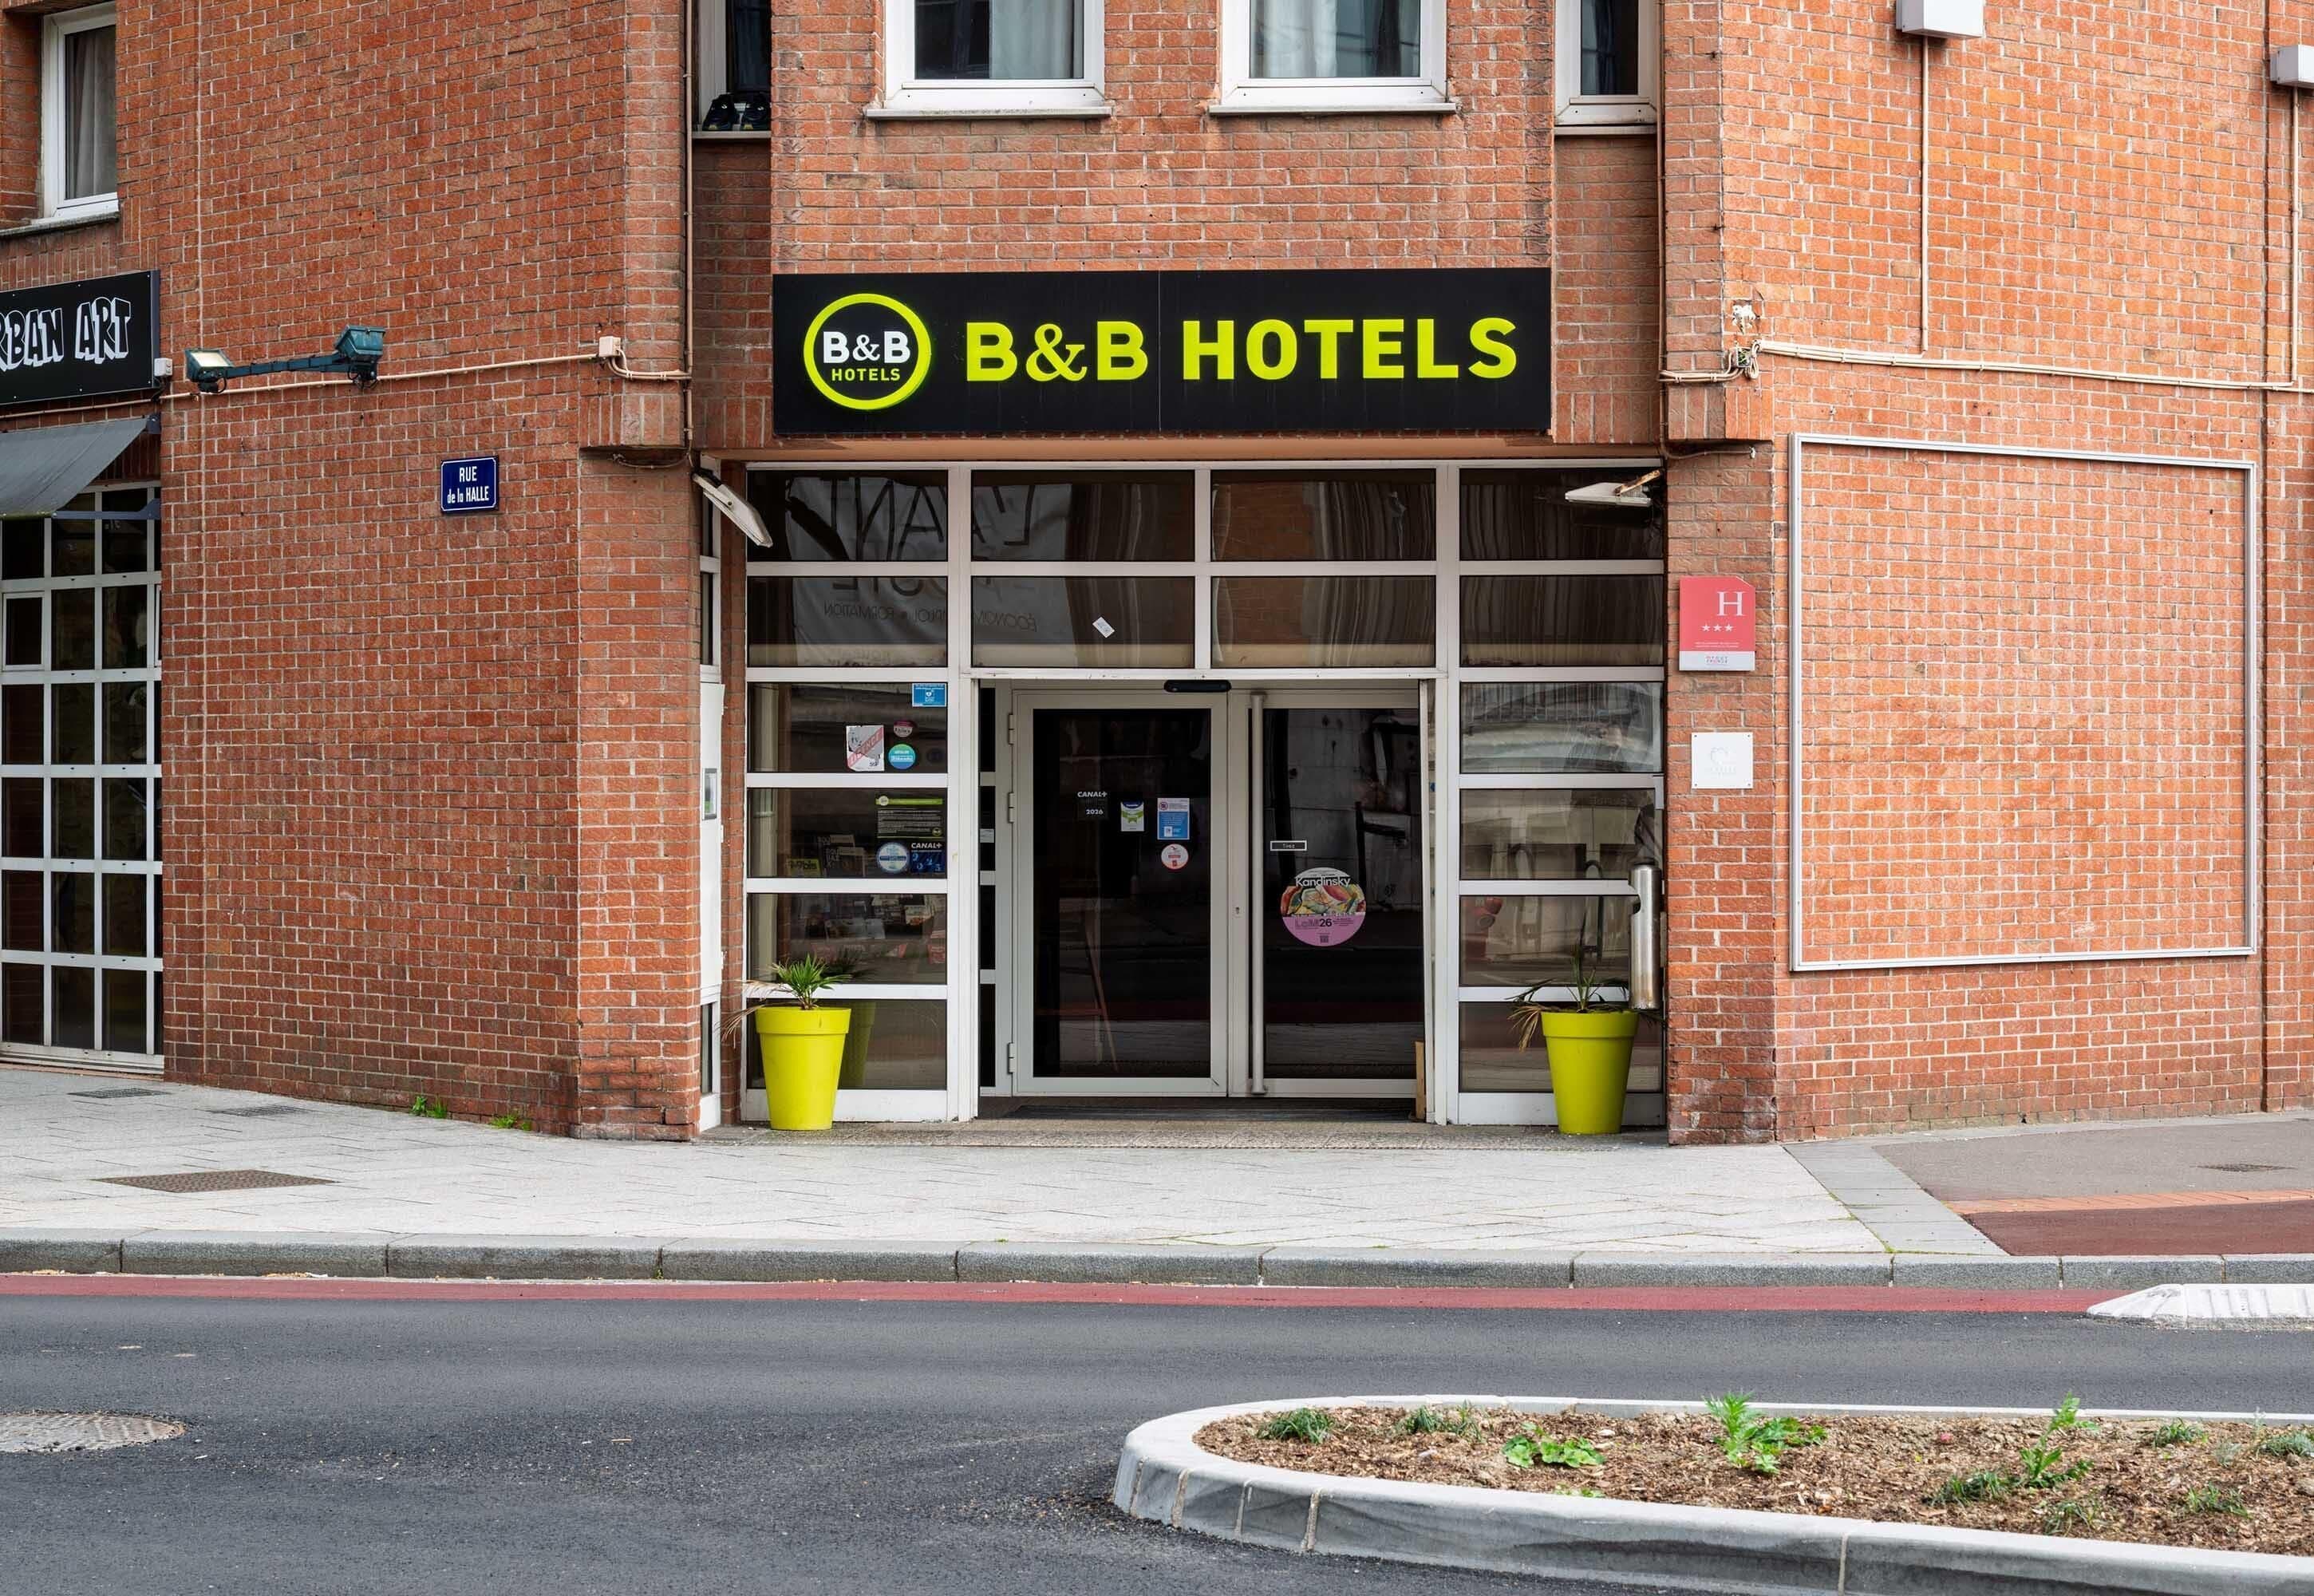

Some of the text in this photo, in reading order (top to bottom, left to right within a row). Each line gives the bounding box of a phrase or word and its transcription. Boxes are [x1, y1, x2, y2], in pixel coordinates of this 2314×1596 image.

[75, 296, 131, 364] ART
[823, 331, 910, 364] B&B
[966, 317, 1517, 382] B&B HOTELS
[831, 368, 901, 381] HOTELS
[459, 465, 478, 483] RUE
[447, 485, 490, 504] de la HALLE
[1716, 591, 1746, 617] H
[1295, 875, 1351, 887] Kandinsky
